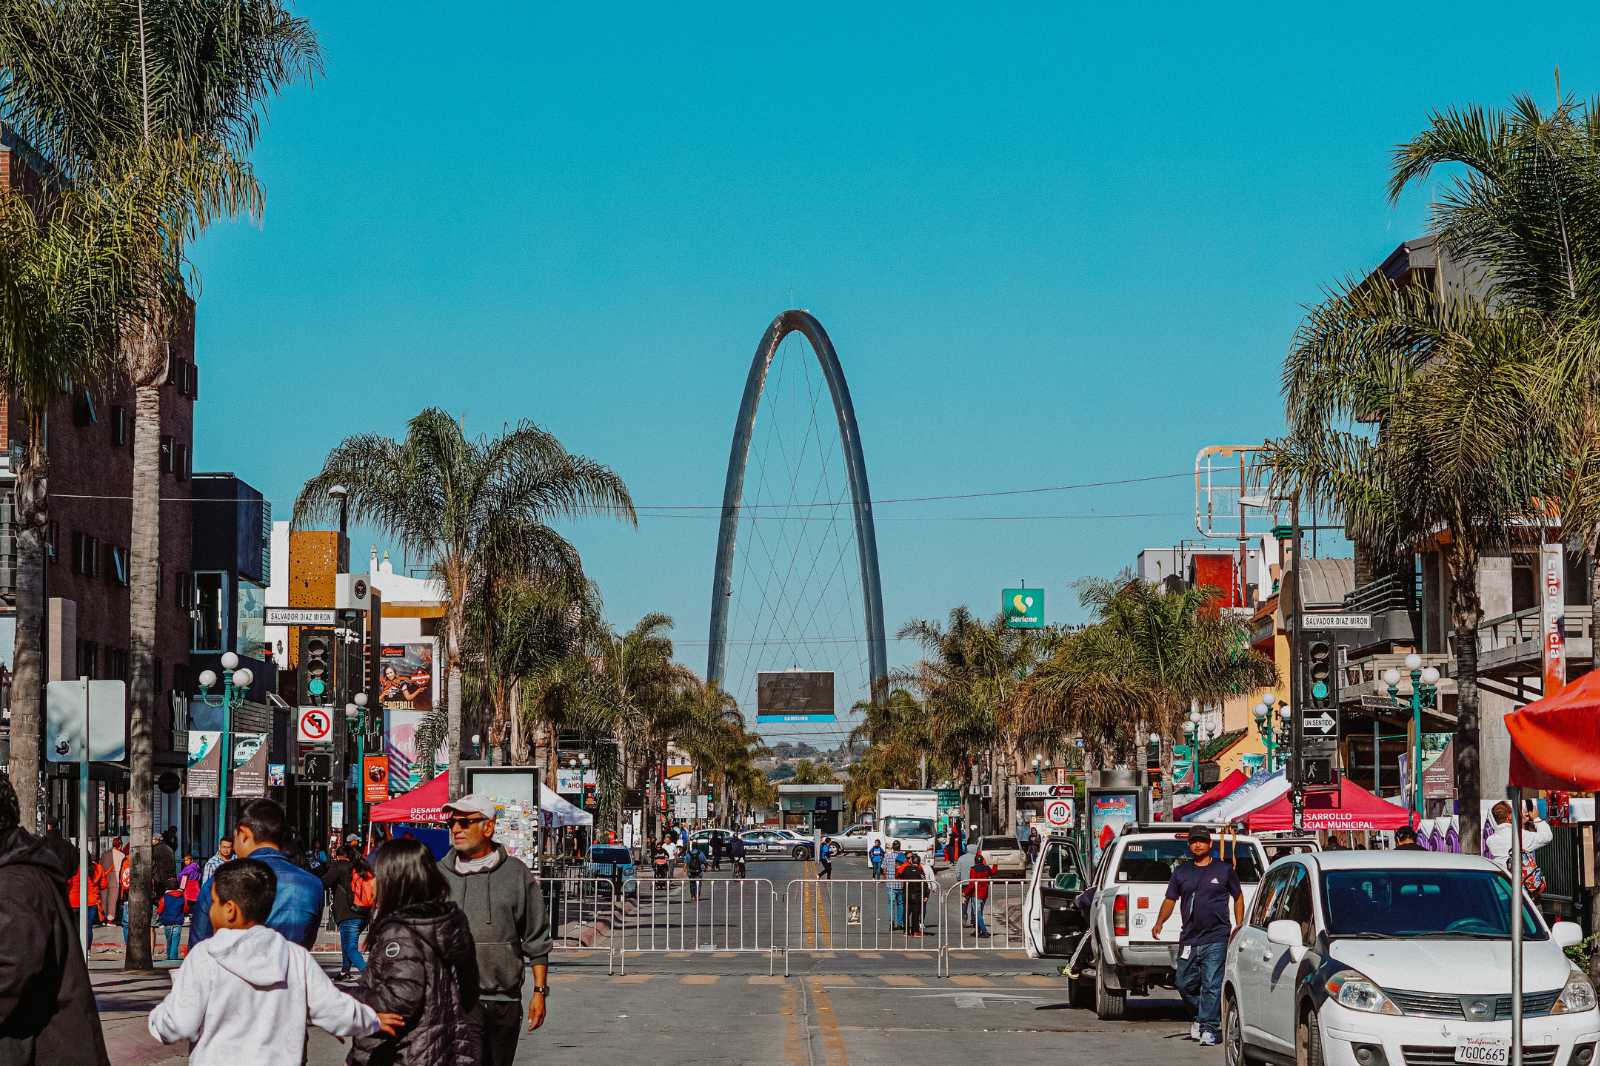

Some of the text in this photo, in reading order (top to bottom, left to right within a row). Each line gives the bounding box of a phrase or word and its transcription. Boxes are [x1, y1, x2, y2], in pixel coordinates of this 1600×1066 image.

[271, 612, 298, 620] SALVADOR
[314, 613, 331, 621] MIRON
[1306, 617, 1368, 625] SALVADOR DIAZ MIRON
[1053, 806, 1065, 817] 40
[410, 813, 437, 821] SOCIAL
[1302, 812, 1352, 820] ESARROLLO
[1303, 821, 1376, 829] CIAL MUNICIPAL
